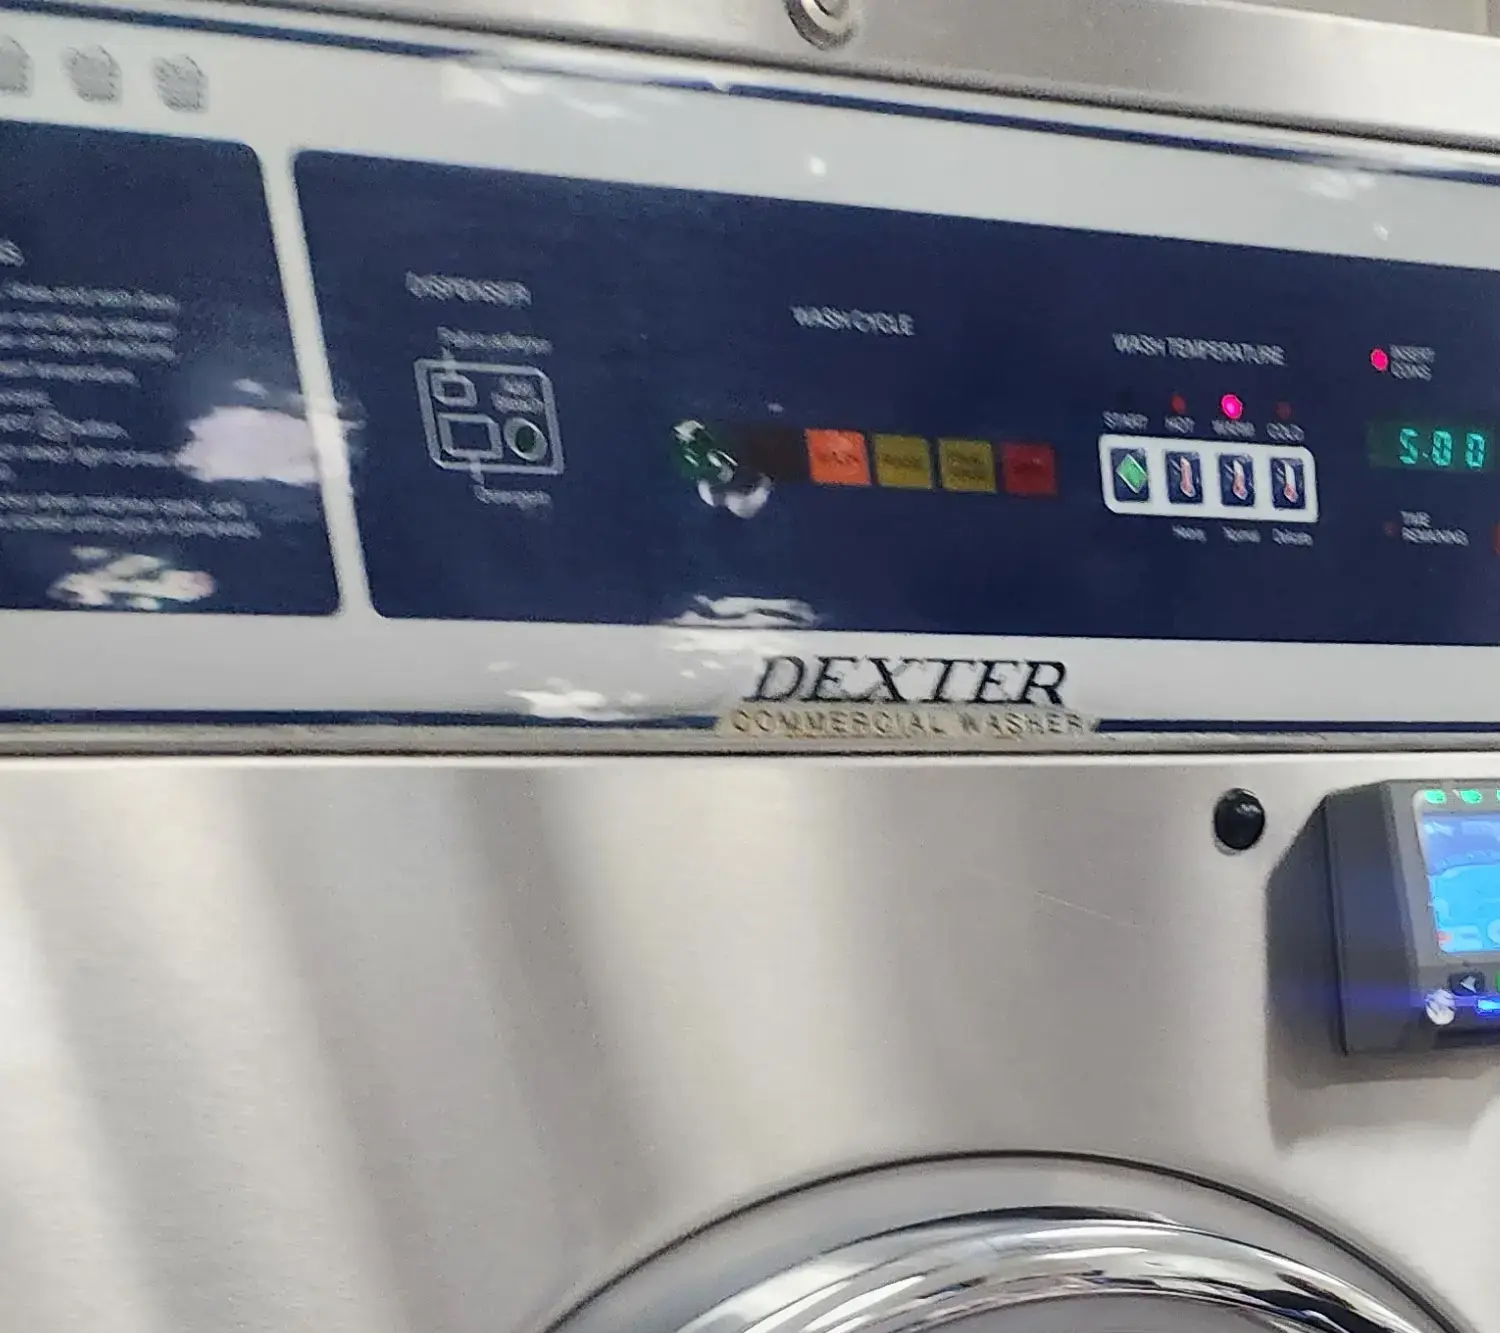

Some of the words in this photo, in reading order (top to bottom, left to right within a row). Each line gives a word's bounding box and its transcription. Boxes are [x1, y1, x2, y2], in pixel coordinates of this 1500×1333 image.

[744, 655, 1066, 705] DEXTER
[731, 707, 946, 738] COMMERCIAL
[960, 710, 1084, 742] WASHER
